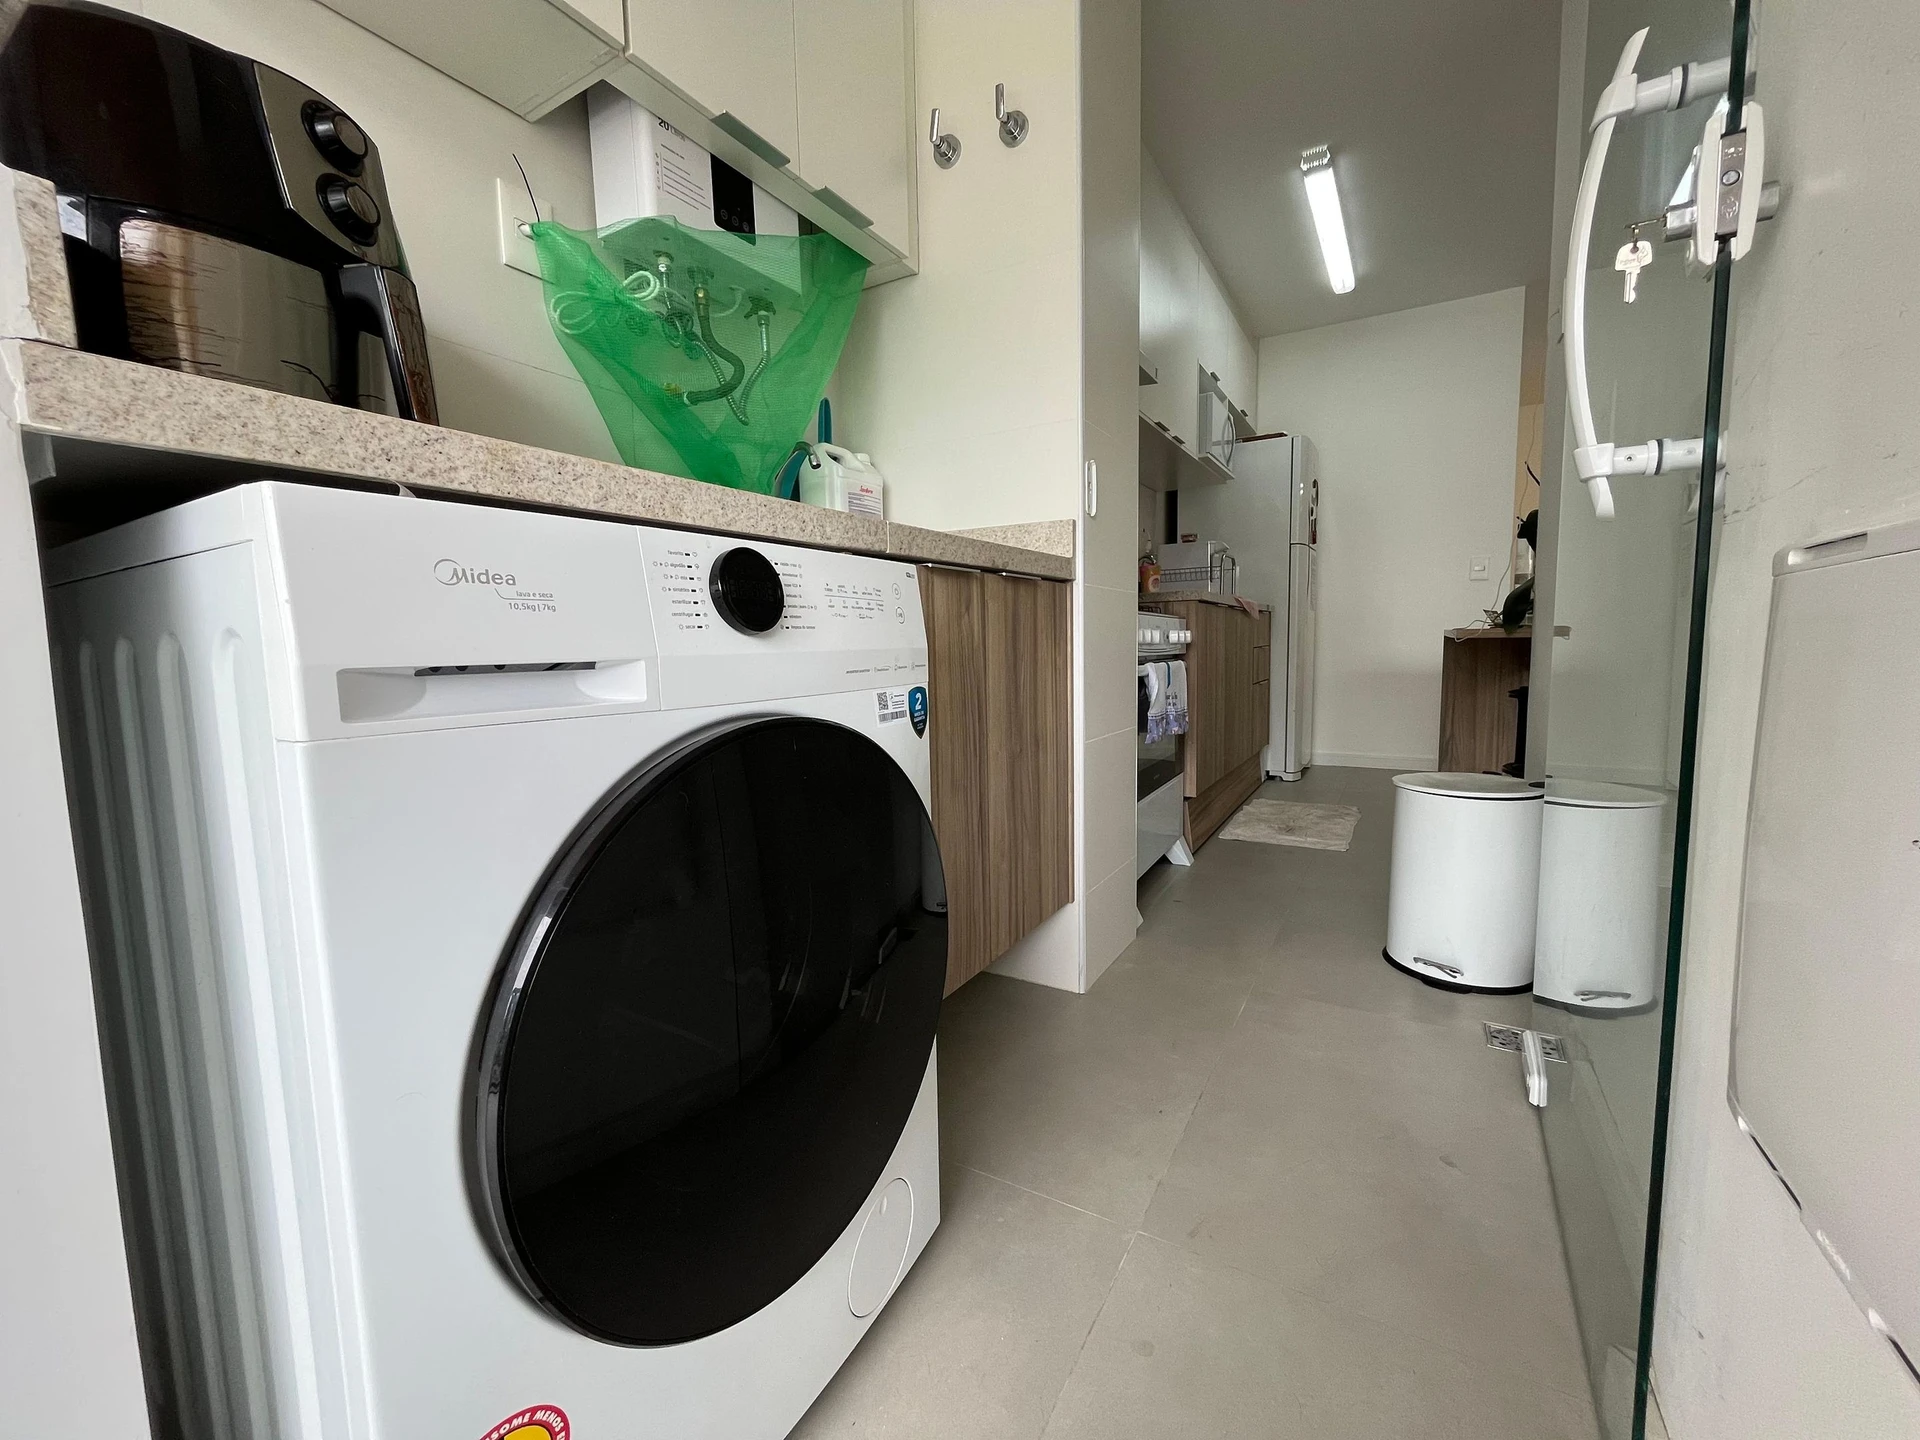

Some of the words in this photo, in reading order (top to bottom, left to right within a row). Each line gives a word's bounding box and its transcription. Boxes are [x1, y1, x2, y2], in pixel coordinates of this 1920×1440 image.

[658, 117, 669, 131] 20
[433, 558, 517, 586] Midea
[515, 590, 531, 598] lava
[915, 692, 922, 710] 2
[485, 1413, 531, 1440] SOME
[533, 1410, 564, 1432] MENOS
